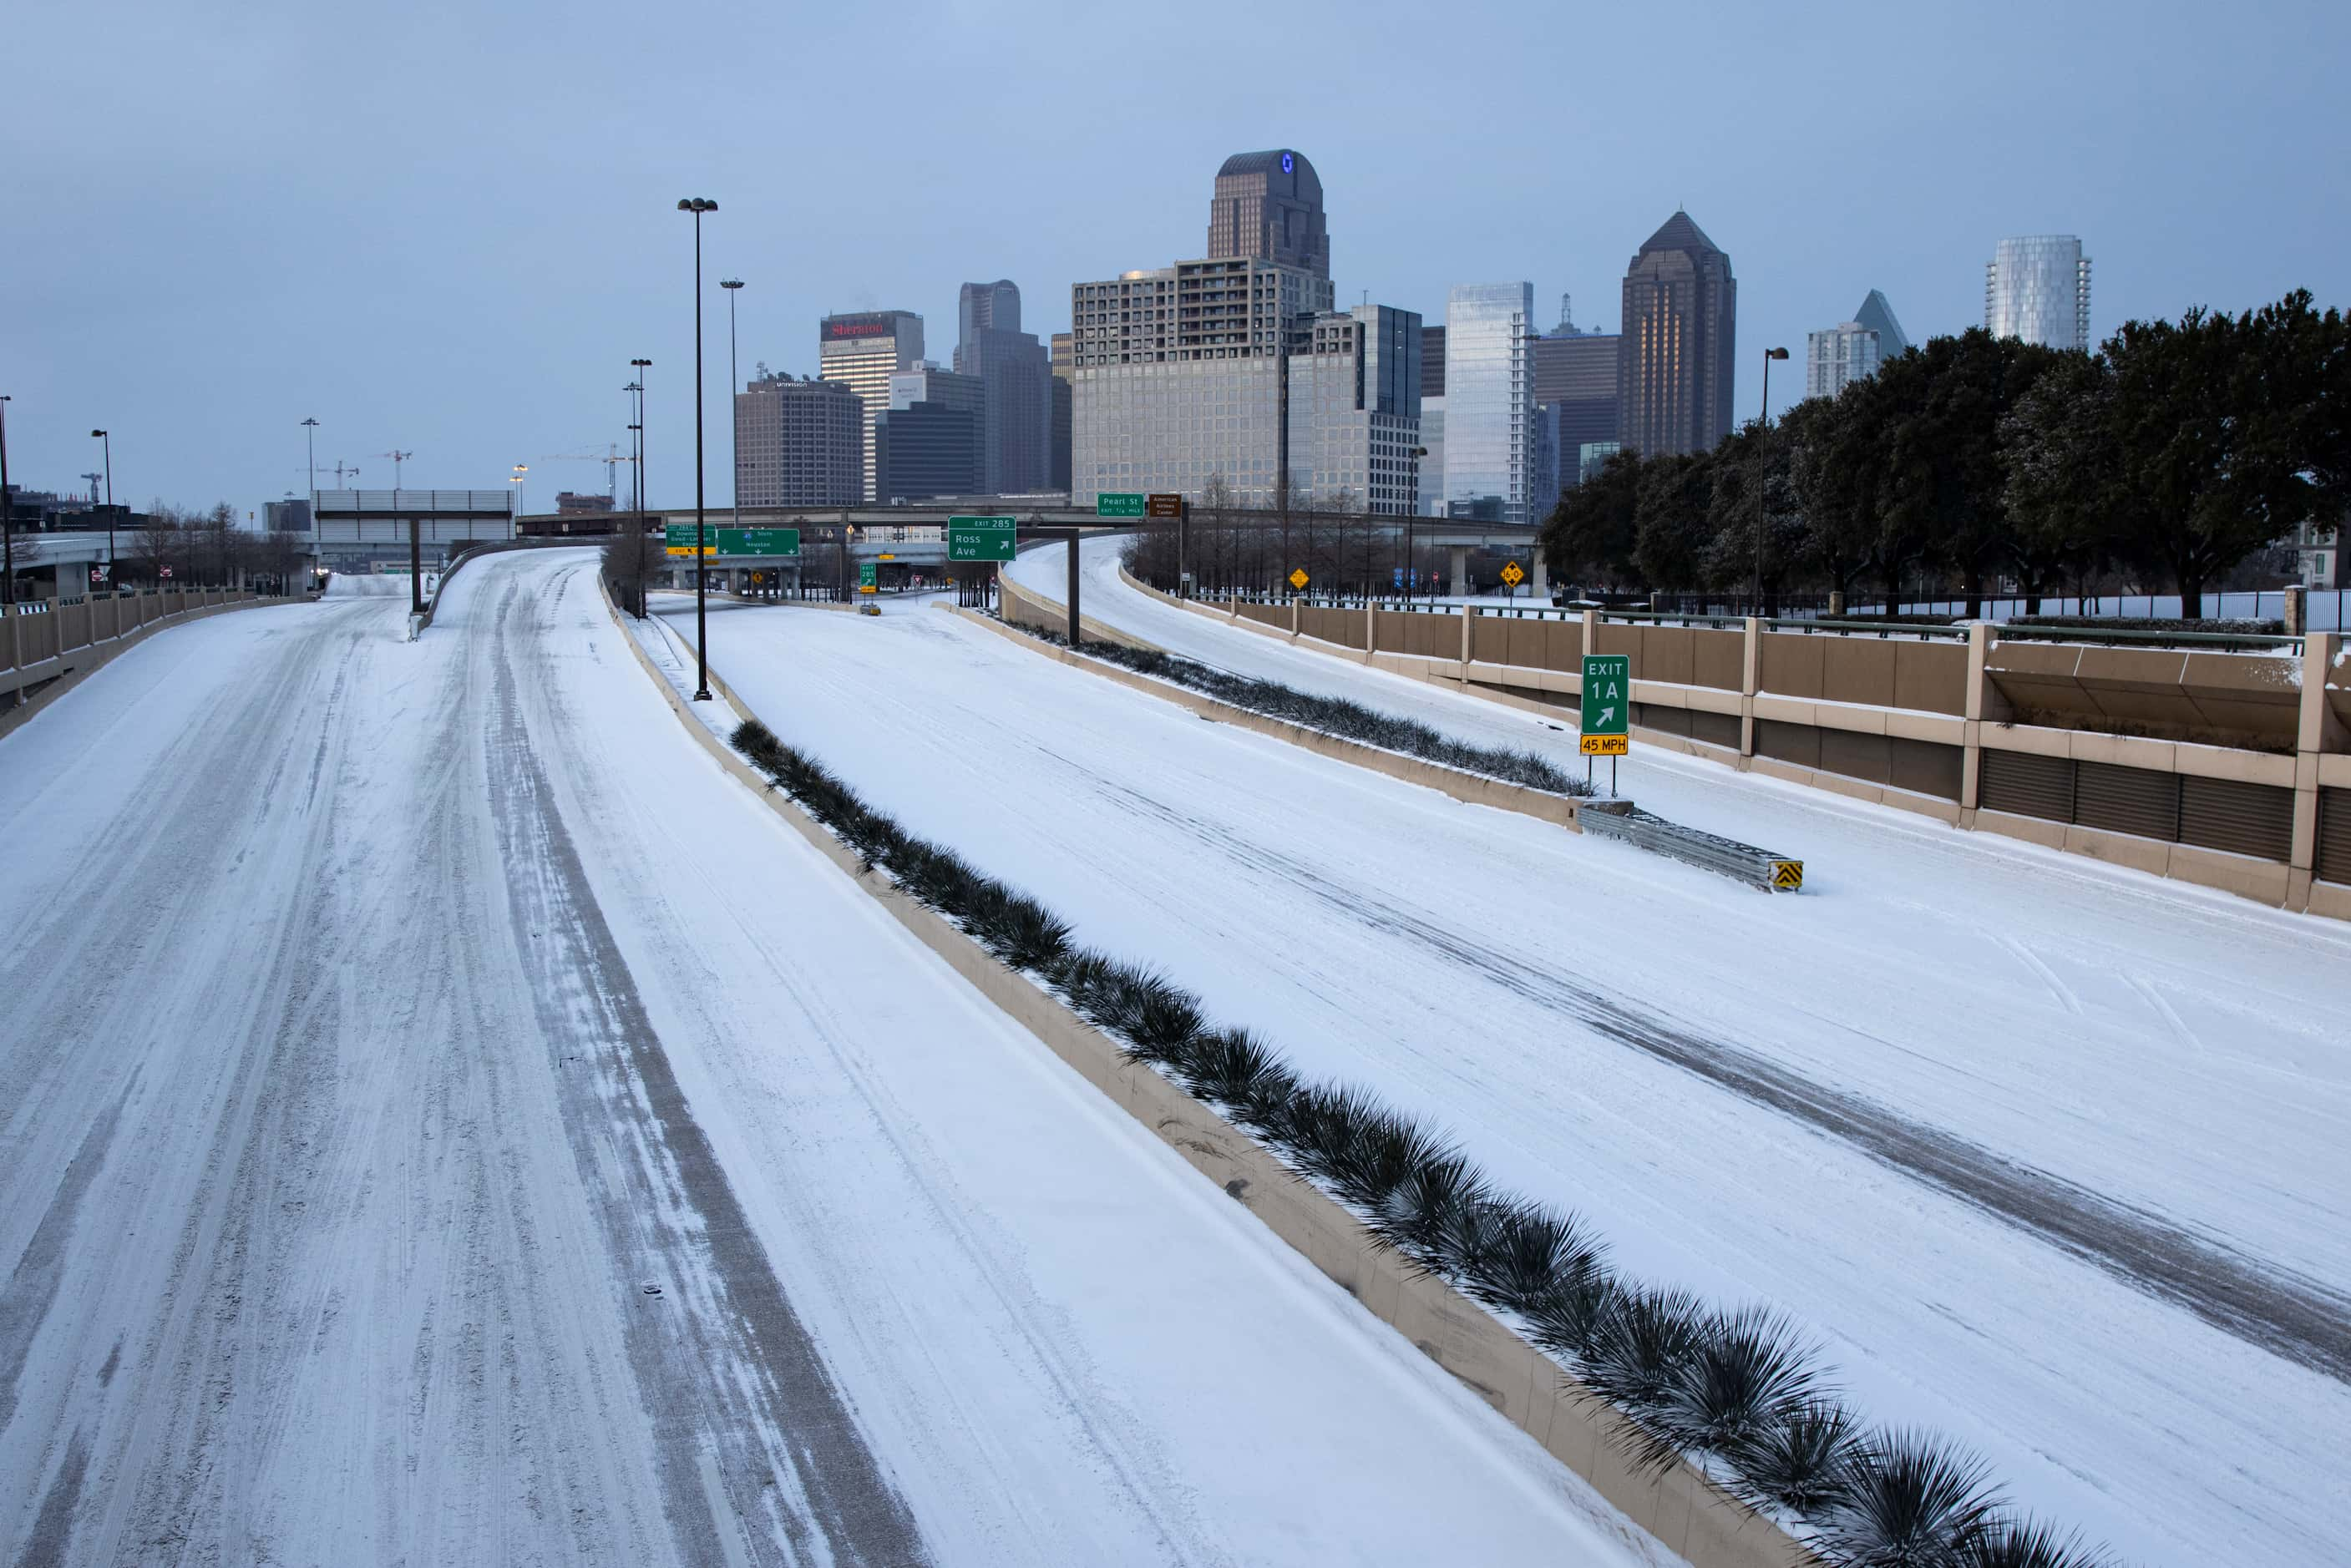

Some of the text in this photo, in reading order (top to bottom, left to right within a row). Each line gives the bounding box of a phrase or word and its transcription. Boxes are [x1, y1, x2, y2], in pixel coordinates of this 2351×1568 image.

[833, 324, 883, 336] Sheraton
[992, 519, 1010, 528] 285
[955, 534, 981, 544] Ross
[955, 547, 976, 556] Ave
[1588, 663, 1623, 675] EXIT
[1592, 681, 1619, 699] 1A
[1583, 738, 1626, 751] 45 MPH
